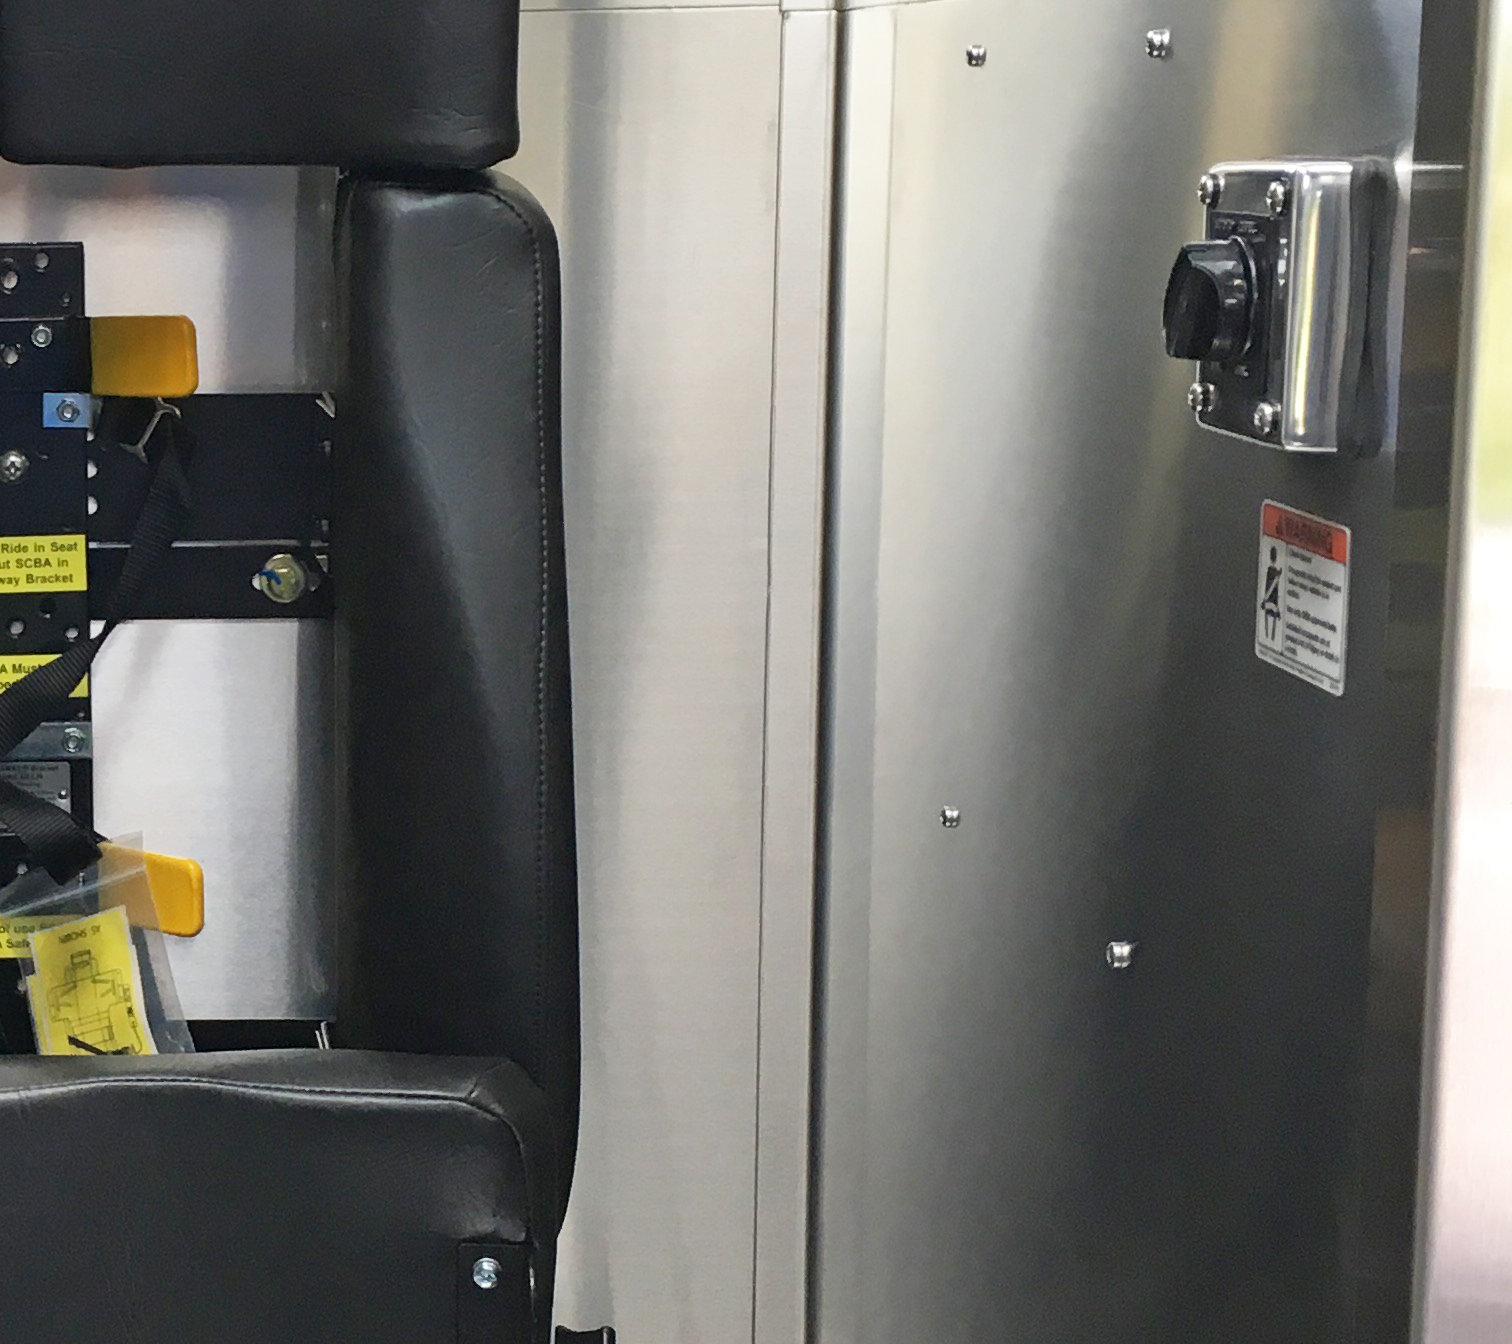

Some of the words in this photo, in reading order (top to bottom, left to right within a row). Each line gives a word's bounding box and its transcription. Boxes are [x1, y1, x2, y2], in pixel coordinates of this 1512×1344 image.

[1, 542, 29, 554] Ride
[34, 542, 45, 553] in
[50, 541, 78, 553] Seat
[15, 557, 52, 569] SCBA
[57, 558, 69, 568] in
[25, 573, 74, 585] Bracket
